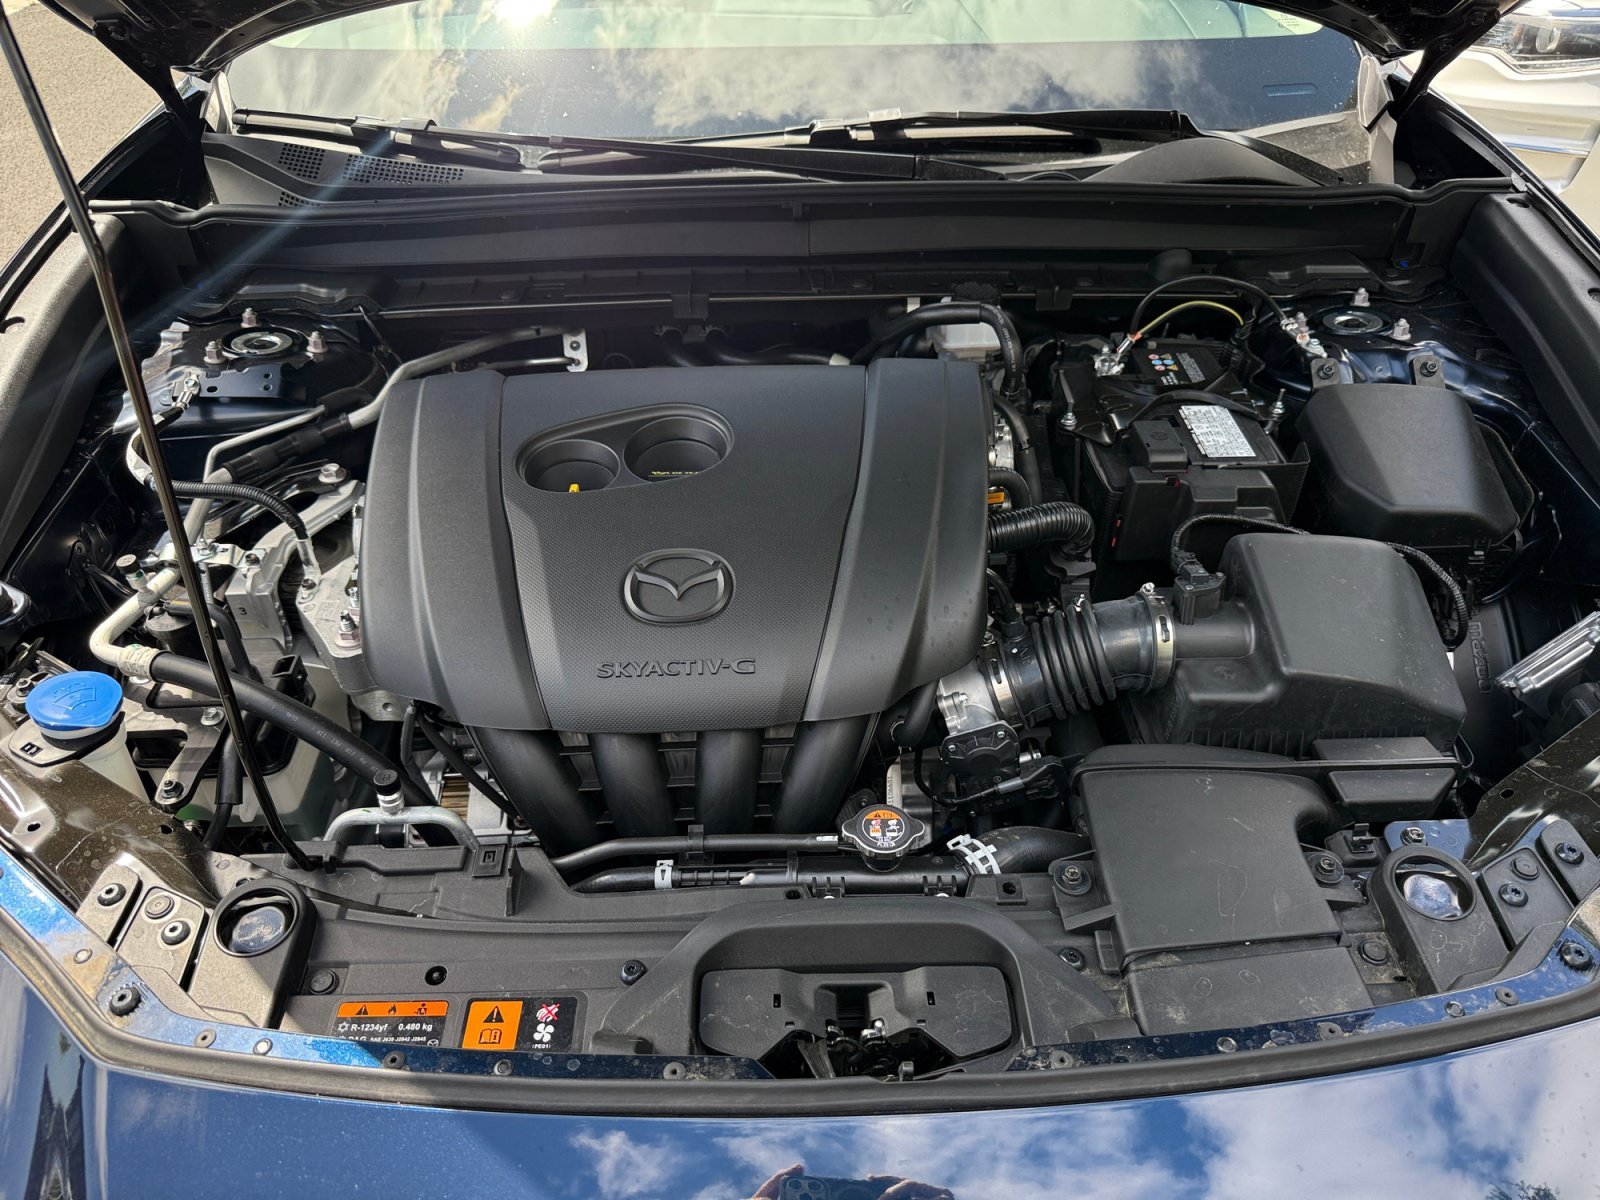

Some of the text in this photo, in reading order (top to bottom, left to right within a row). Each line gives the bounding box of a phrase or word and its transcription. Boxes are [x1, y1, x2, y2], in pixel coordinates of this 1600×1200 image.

[596, 658, 756, 678] SKYACTIV-G
[350, 1022, 433, 1032] R-1234yf 0.480 kg
